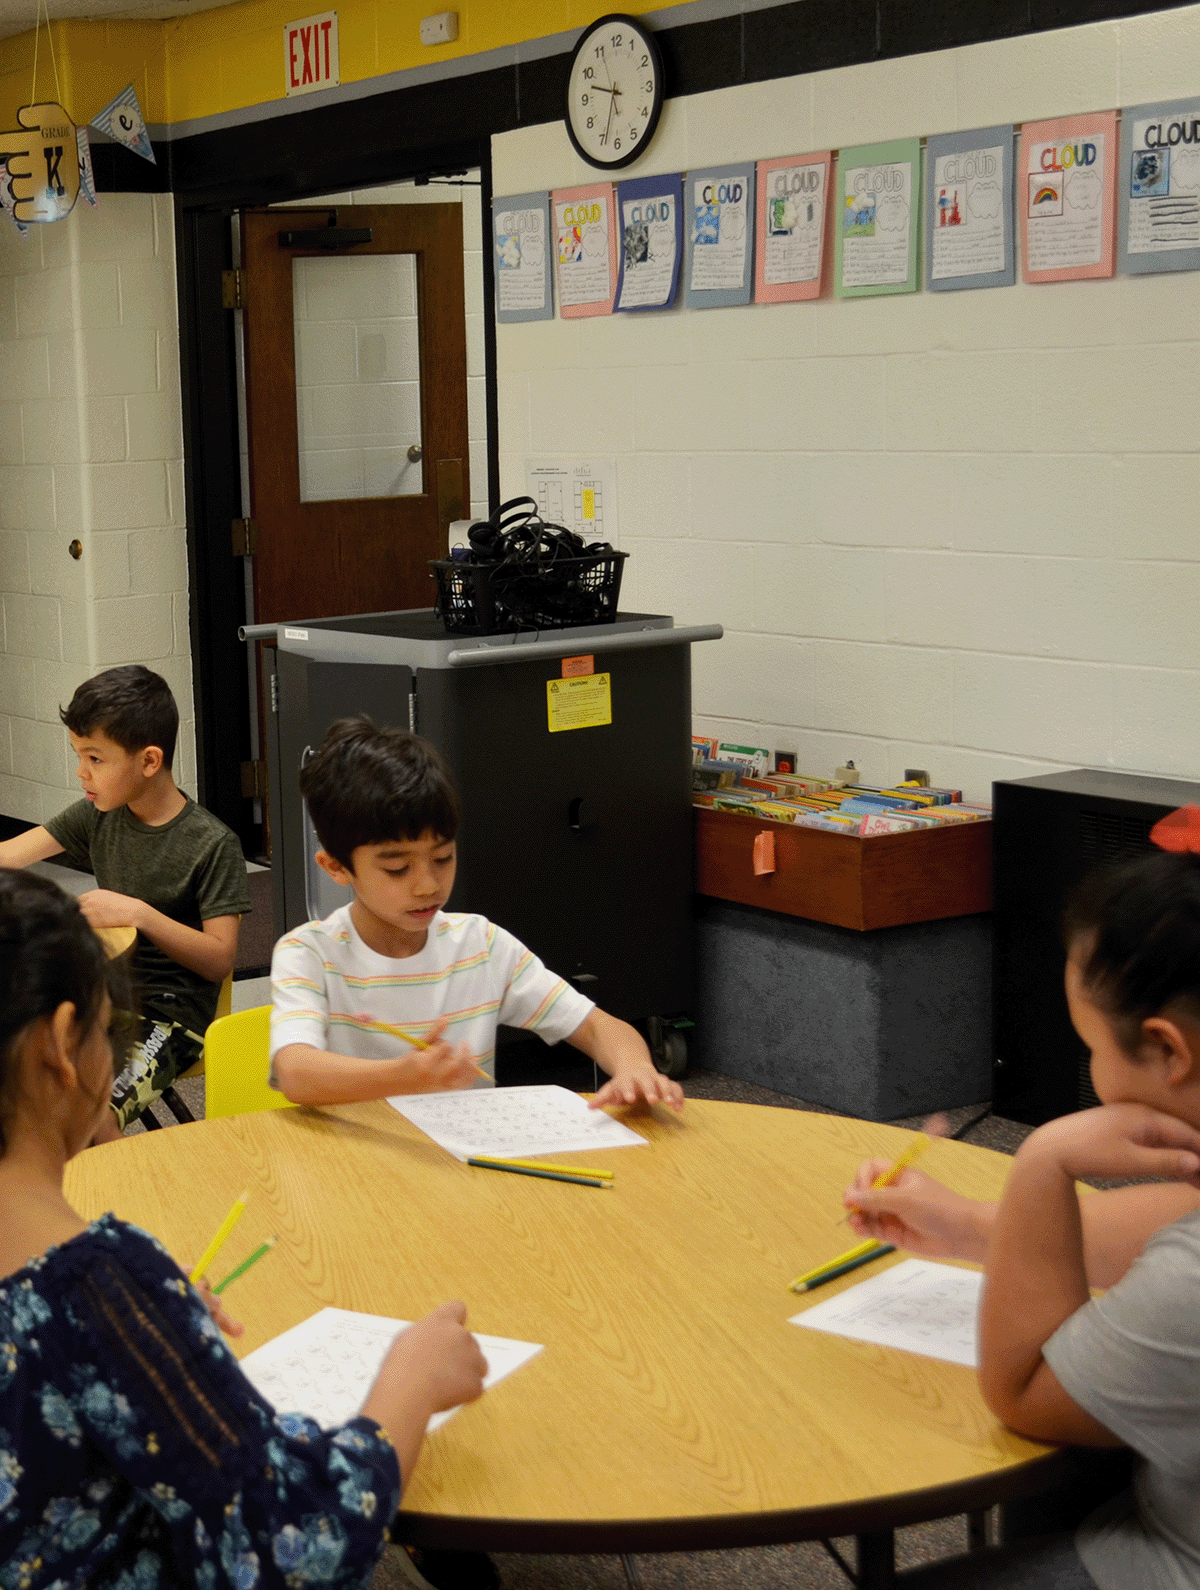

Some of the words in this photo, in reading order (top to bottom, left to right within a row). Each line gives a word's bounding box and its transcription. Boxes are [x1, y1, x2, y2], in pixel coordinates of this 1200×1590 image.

[611, 34, 623, 47] 12
[629, 39, 634, 51] 1
[289, 20, 332, 88] EXIT
[594, 46, 605, 58] 11
[641, 55, 649, 68] 2
[582, 66, 594, 80] 10
[645, 80, 653, 93] 3
[581, 94, 589, 106] 9
[641, 106, 649, 118] 4
[586, 117, 594, 129] 8
[41, 126, 72, 140] GRADE
[599, 133, 606, 146] 7
[630, 128, 638, 140] 5
[614, 138, 621, 150] 6
[1040, 143, 1097, 171] CLOUD
[43, 145, 66, 199] K
[944, 154, 997, 183] CLOUD
[774, 170, 820, 196] CLOUD
[854, 169, 905, 195] CLOUD
[702, 183, 743, 205] CLOUD
[563, 203, 601, 226] CLOUD
[631, 202, 670, 224] CLOUD
[503, 214, 540, 233] CLOUD
